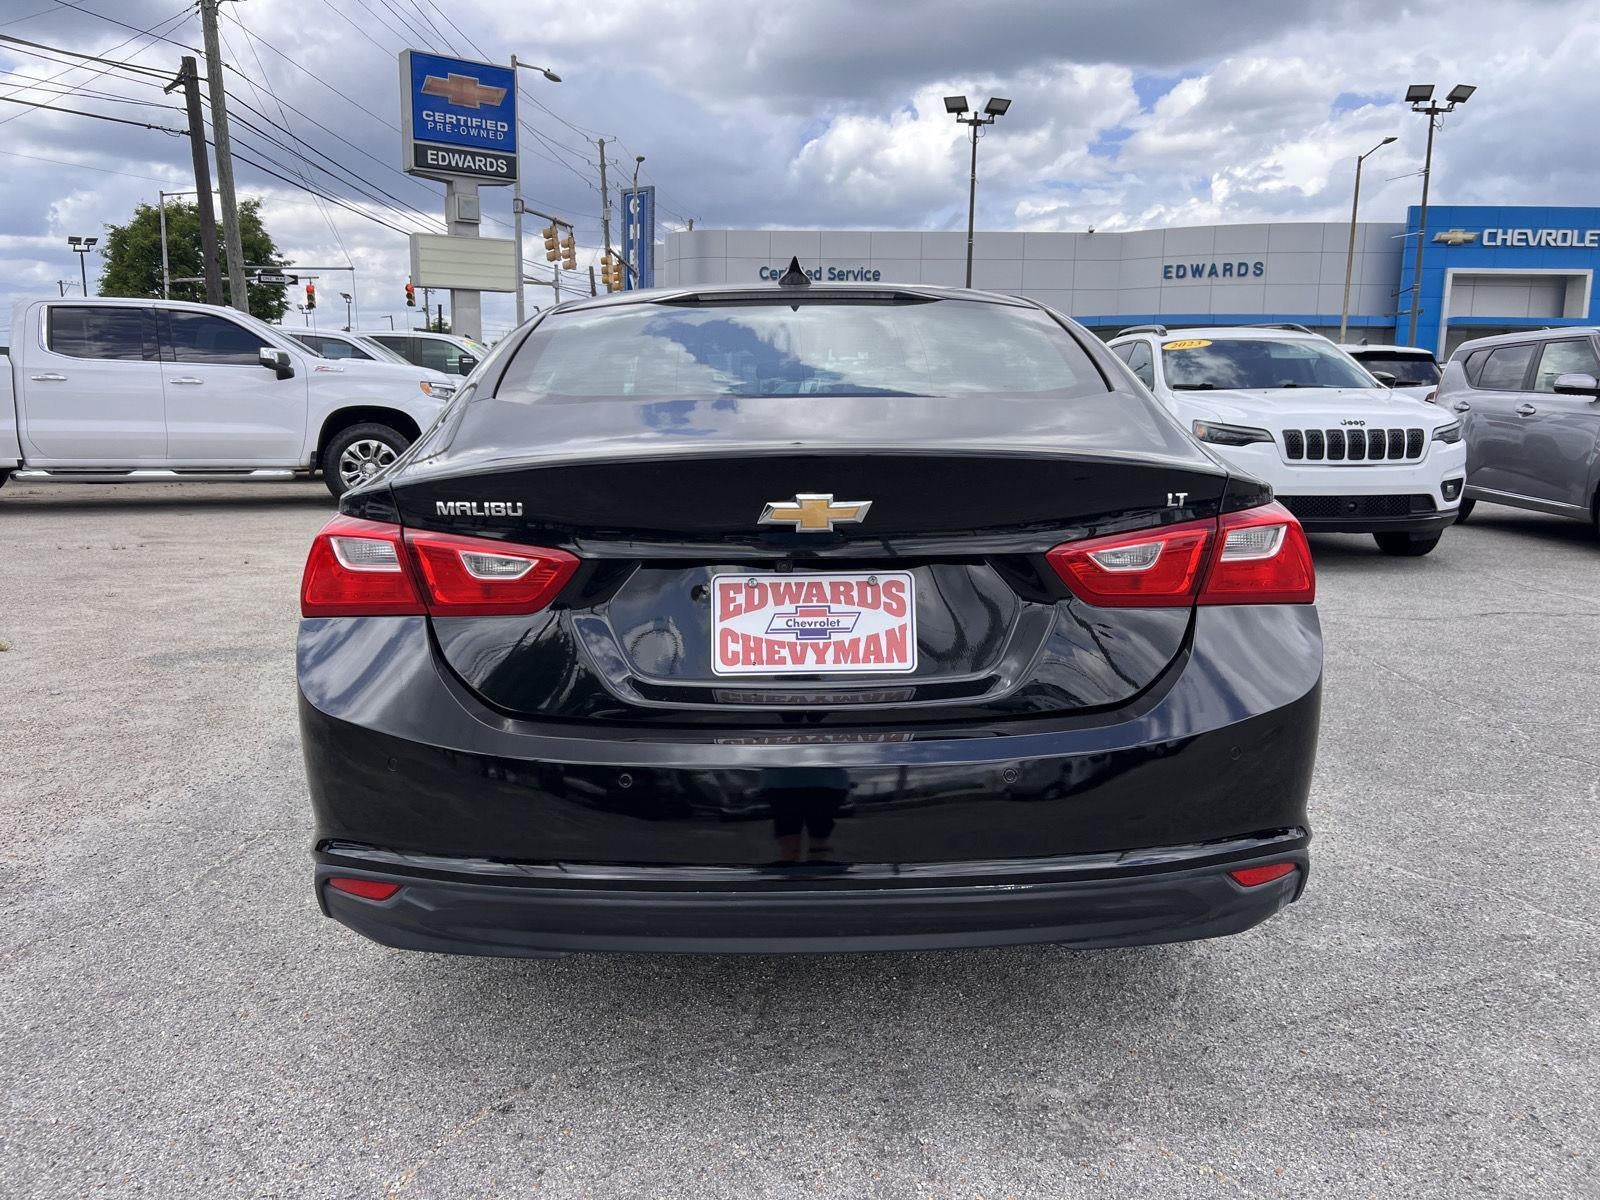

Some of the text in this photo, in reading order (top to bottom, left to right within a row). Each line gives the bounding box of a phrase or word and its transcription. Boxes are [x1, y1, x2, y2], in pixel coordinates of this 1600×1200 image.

[422, 110, 508, 132] CERTIFIED
[427, 121, 504, 140] PRE-OWNED
[427, 150, 507, 173] EDWARDS
[1482, 228, 1600, 247] CHEVROLE
[828, 267, 881, 281] Service
[1163, 261, 1264, 280] EDWARDS
[1341, 419, 1365, 427] Jeep
[436, 501, 523, 517] MALIBU
[1167, 492, 1188, 508] LT
[719, 580, 907, 622] EDWARDS
[785, 618, 841, 628] Chevrolet
[719, 623, 908, 667] CHEVYMAN
